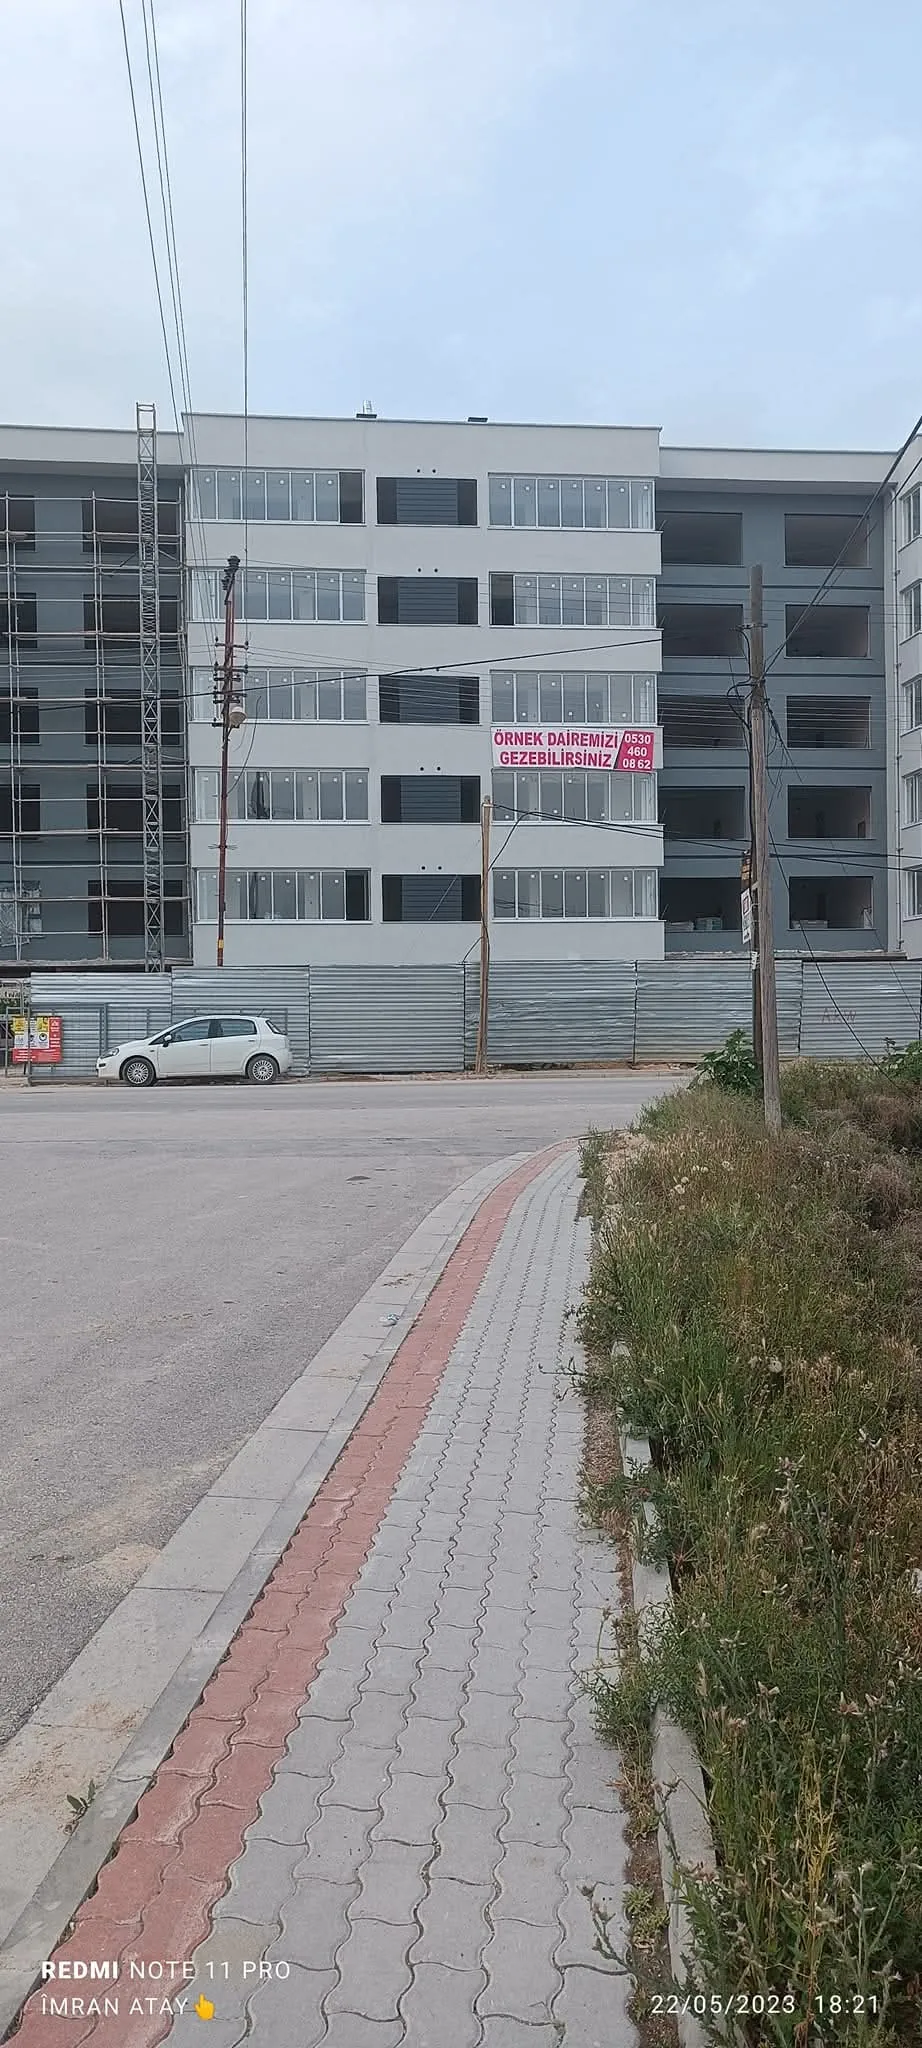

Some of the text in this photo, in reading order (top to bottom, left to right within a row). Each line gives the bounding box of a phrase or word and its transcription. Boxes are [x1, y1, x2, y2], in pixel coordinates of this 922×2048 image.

[494, 729, 618, 748] ÖRNEK DAİREMİZİ
[624, 733, 650, 745] 0530
[500, 748, 612, 767] GEZEBİLİRSİNİZ
[627, 746, 647, 757] 460
